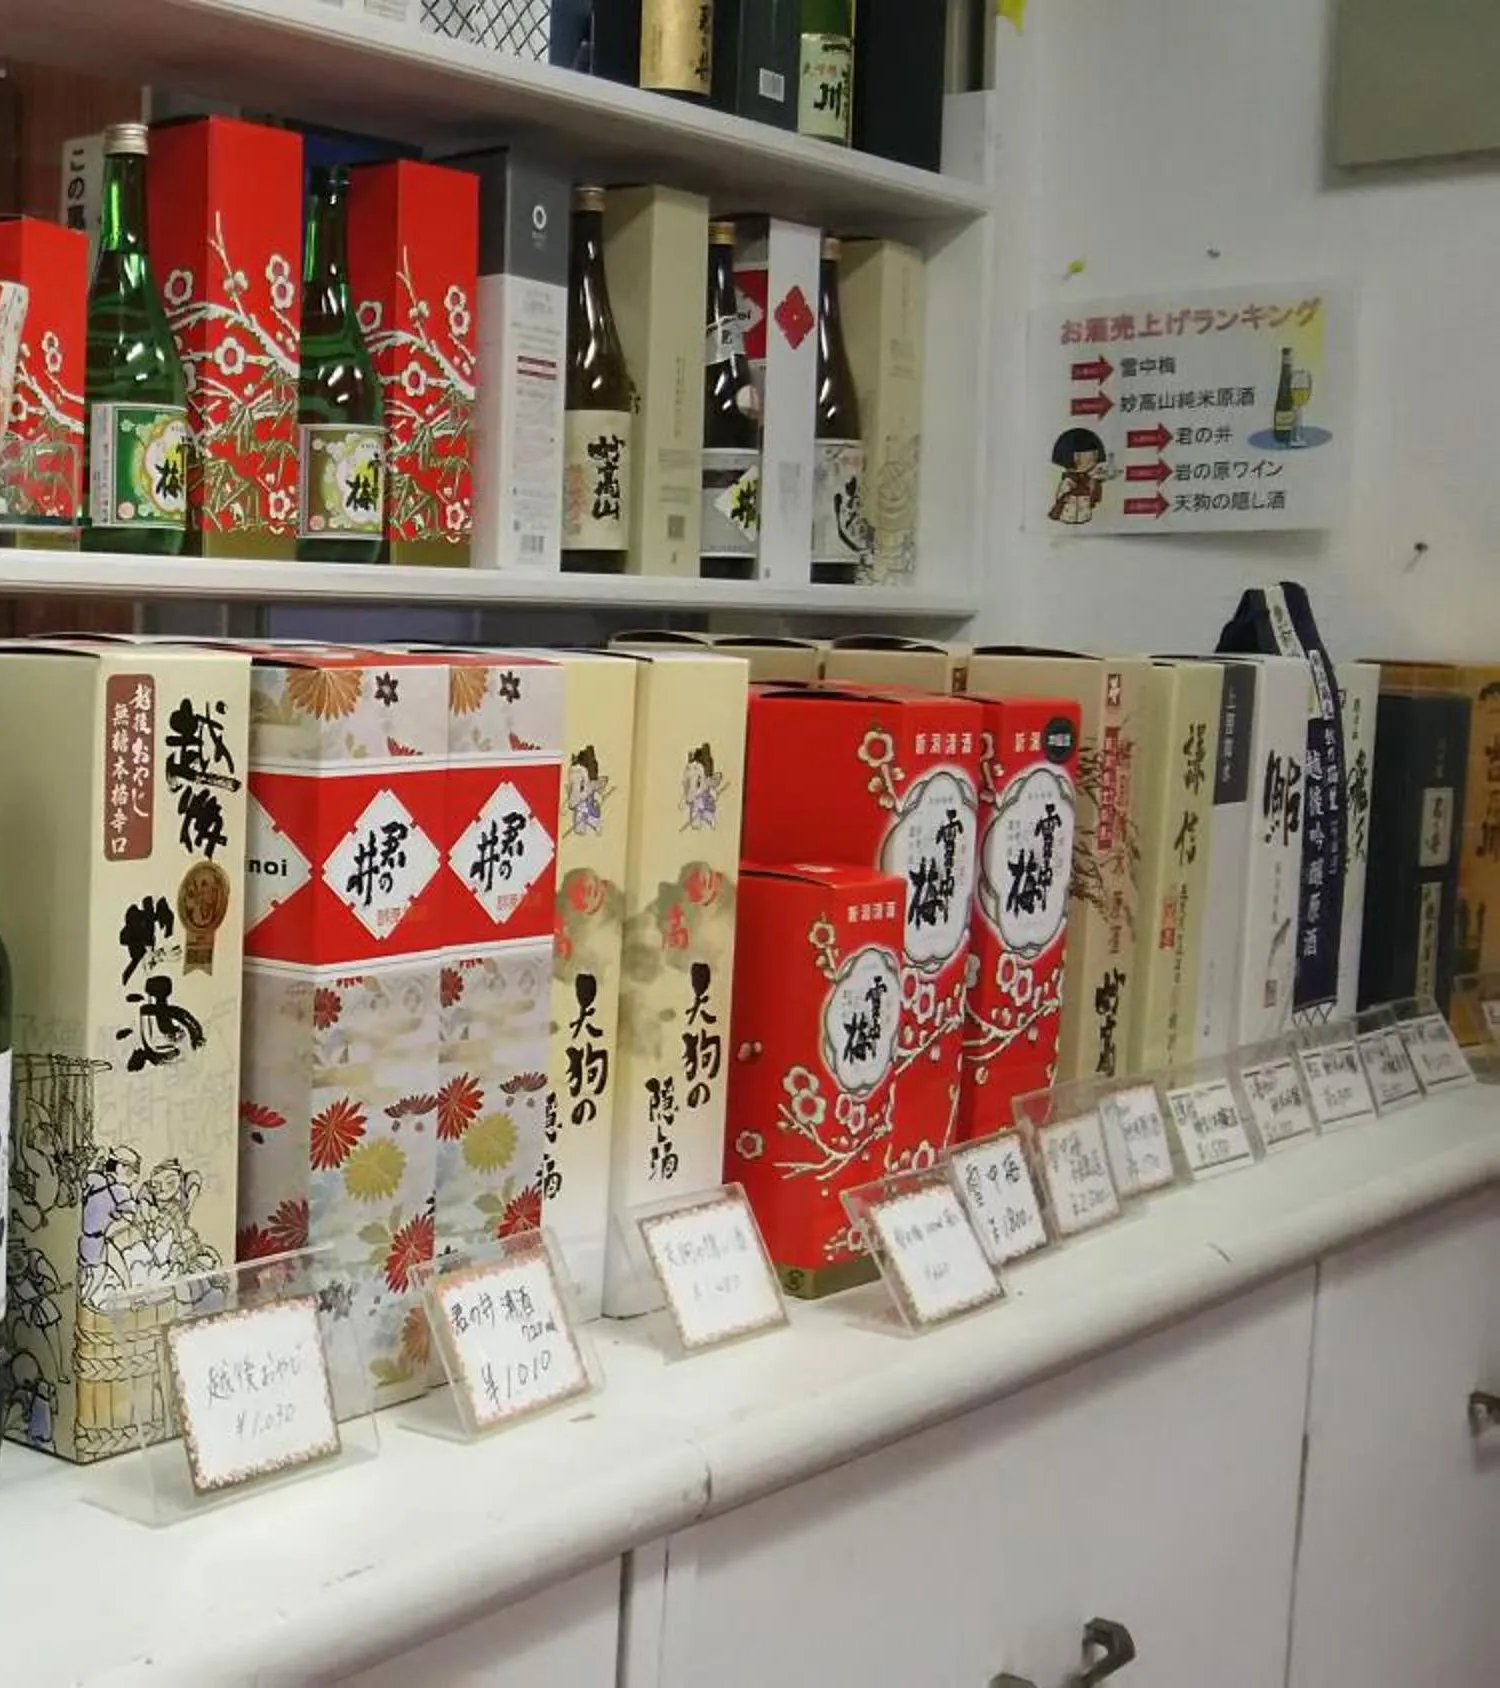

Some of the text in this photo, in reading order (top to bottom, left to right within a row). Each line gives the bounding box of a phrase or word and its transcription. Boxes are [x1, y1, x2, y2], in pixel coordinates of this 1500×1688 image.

[1060, 297, 1323, 345] お酒売上げランキング
[1120, 357, 1176, 378] 雪中梅
[1120, 386, 1256, 414] 妙高山純米原酒
[1175, 426, 1233, 445] 君の井
[587, 434, 626, 521] 妙高山
[1175, 461, 1284, 482] 岩の原ワイン
[1172, 491, 1287, 513] 天狗の隠し酒
[129, 683, 152, 818] 越後おやじ
[566, 973, 610, 1126] 天狗の
[682, 962, 722, 1109] 天狗の
